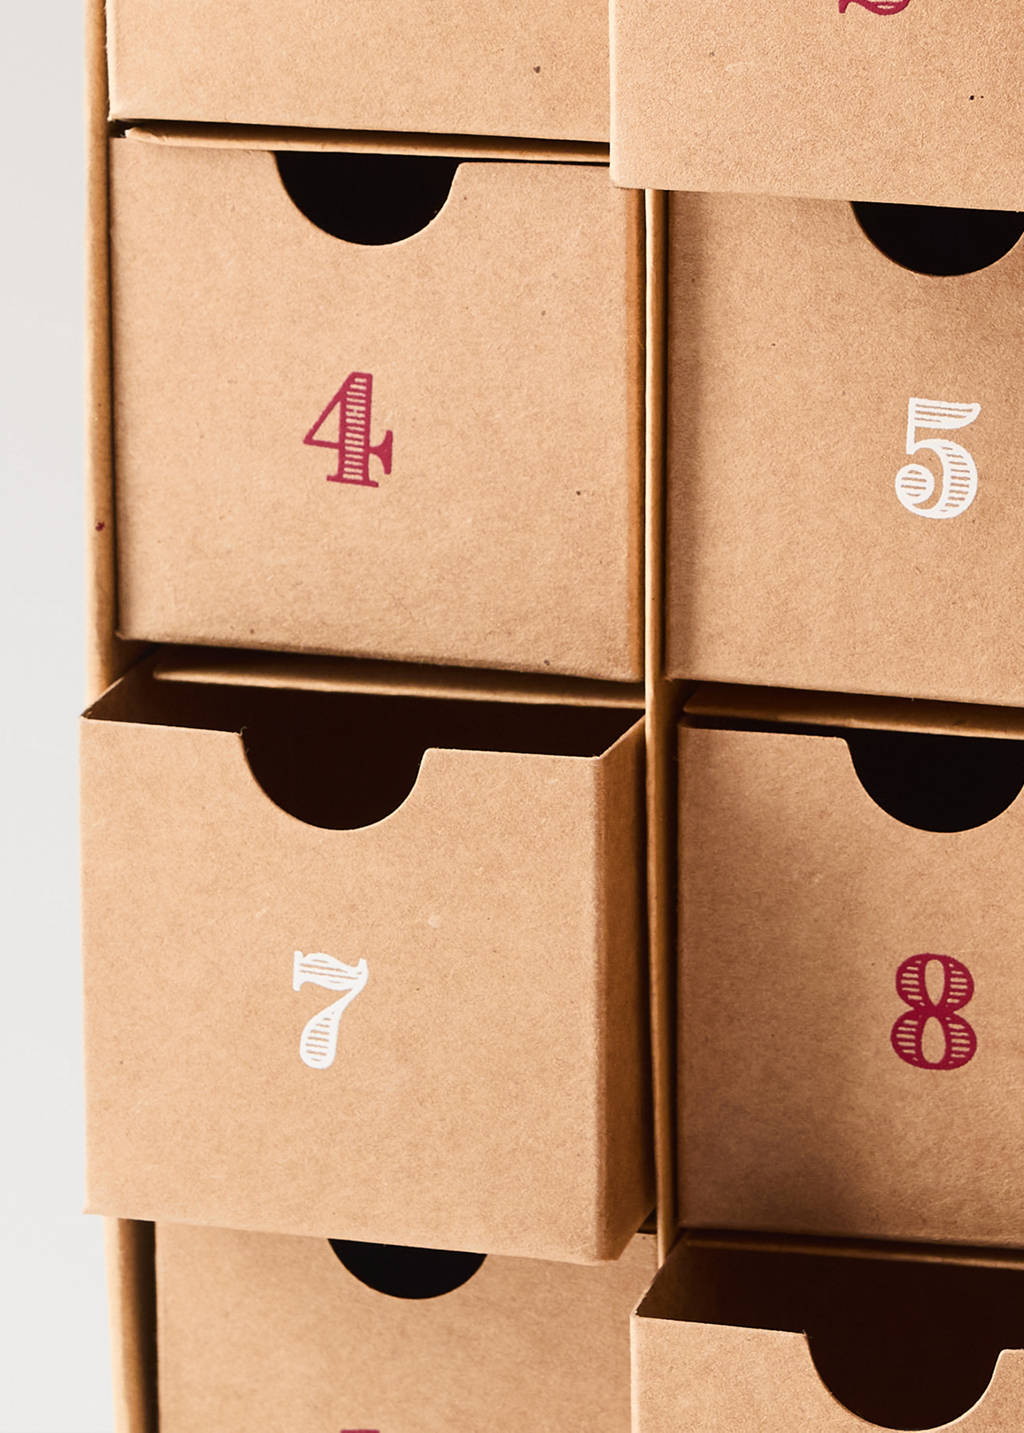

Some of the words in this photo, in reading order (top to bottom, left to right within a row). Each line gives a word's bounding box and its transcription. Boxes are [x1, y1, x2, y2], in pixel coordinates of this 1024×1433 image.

[304, 372, 392, 487] 4
[895, 398, 981, 518] 5
[293, 951, 368, 1069] 7
[891, 953, 976, 1069] 8
